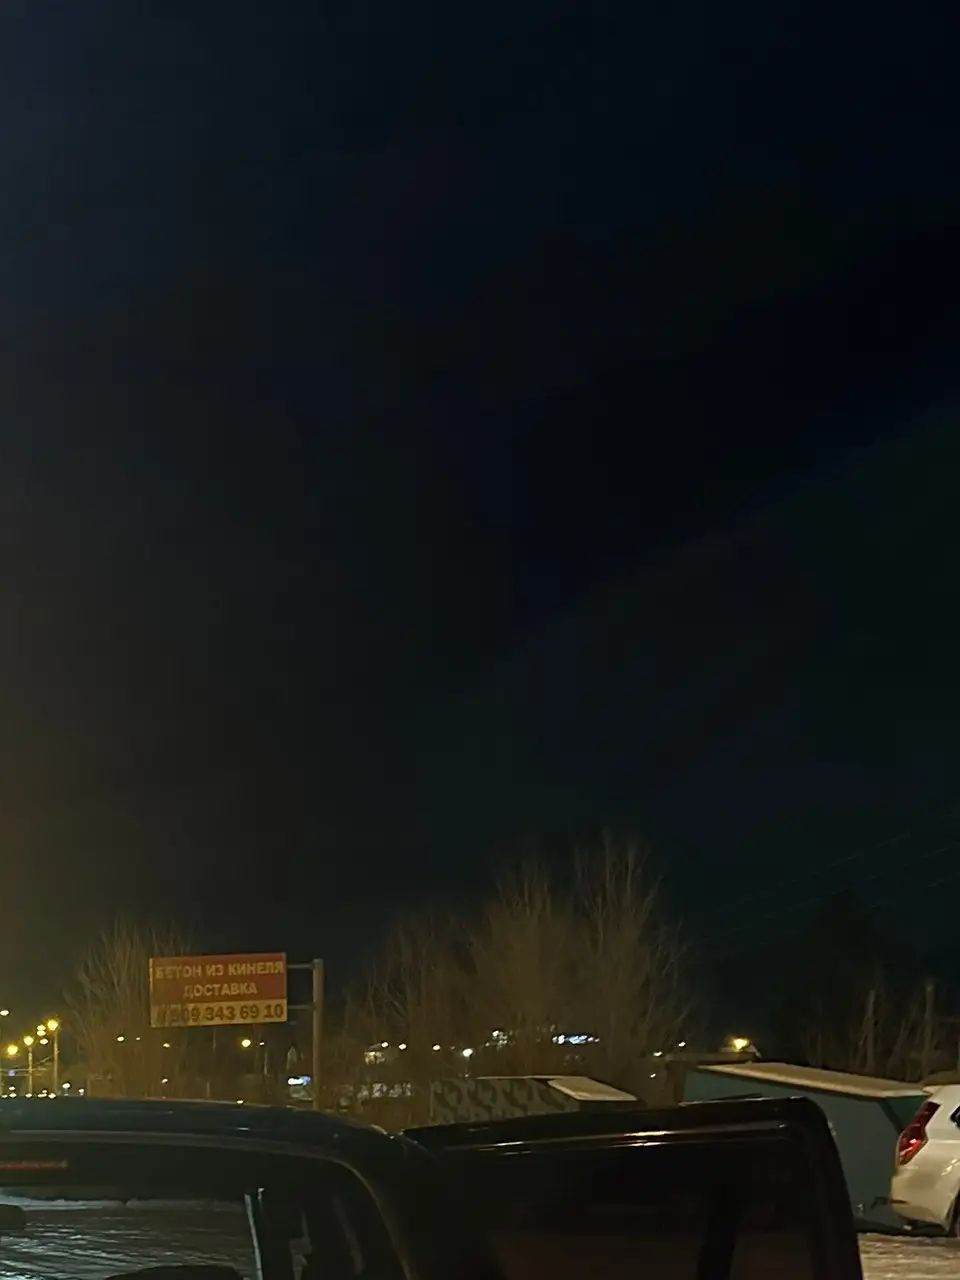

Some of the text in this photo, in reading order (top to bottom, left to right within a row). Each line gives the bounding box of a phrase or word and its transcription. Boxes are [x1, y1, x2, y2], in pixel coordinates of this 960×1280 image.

[155, 961, 283, 979] БЕТОН ИЗ КИНЕЛЯ
[183, 983, 258, 998] ДОСТАВКА
[205, 1005, 236, 1021] 343
[240, 1004, 259, 1019] 69
[263, 1003, 284, 1018] 10
